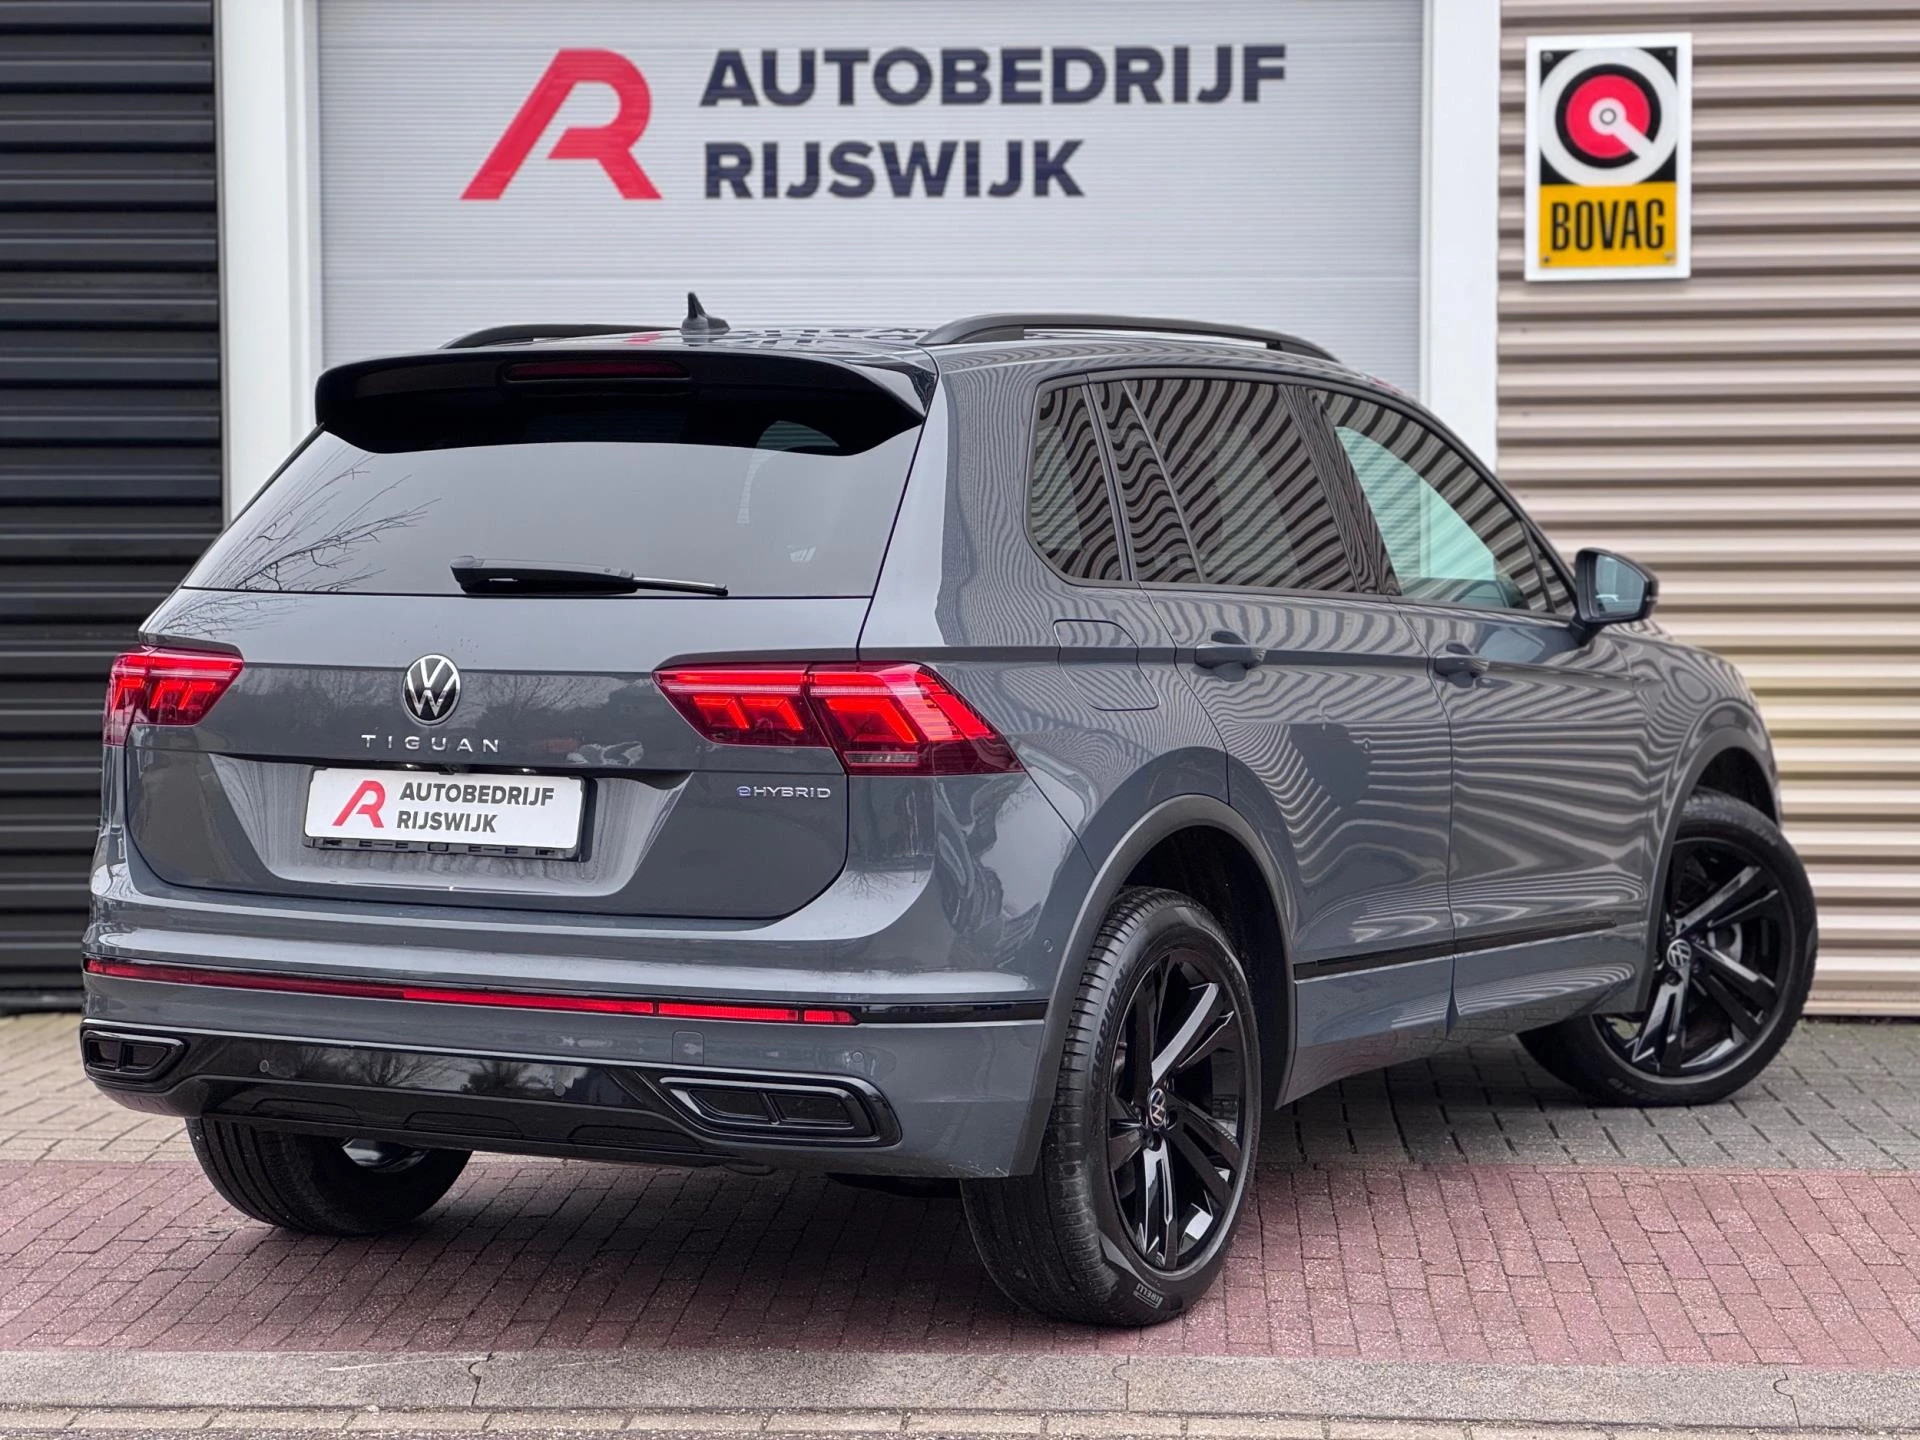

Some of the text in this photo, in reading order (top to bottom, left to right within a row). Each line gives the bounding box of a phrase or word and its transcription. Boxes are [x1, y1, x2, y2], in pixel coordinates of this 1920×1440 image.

[701, 45, 1286, 107] AUTOBEDRIJF
[705, 140, 1084, 199] RIJSWIJK
[1552, 199, 1665, 251] BOVAG
[361, 734, 499, 753] TIGUAN
[400, 782, 554, 807] AUTOBEDRIJF
[396, 810, 498, 833] RIJSWIJK
